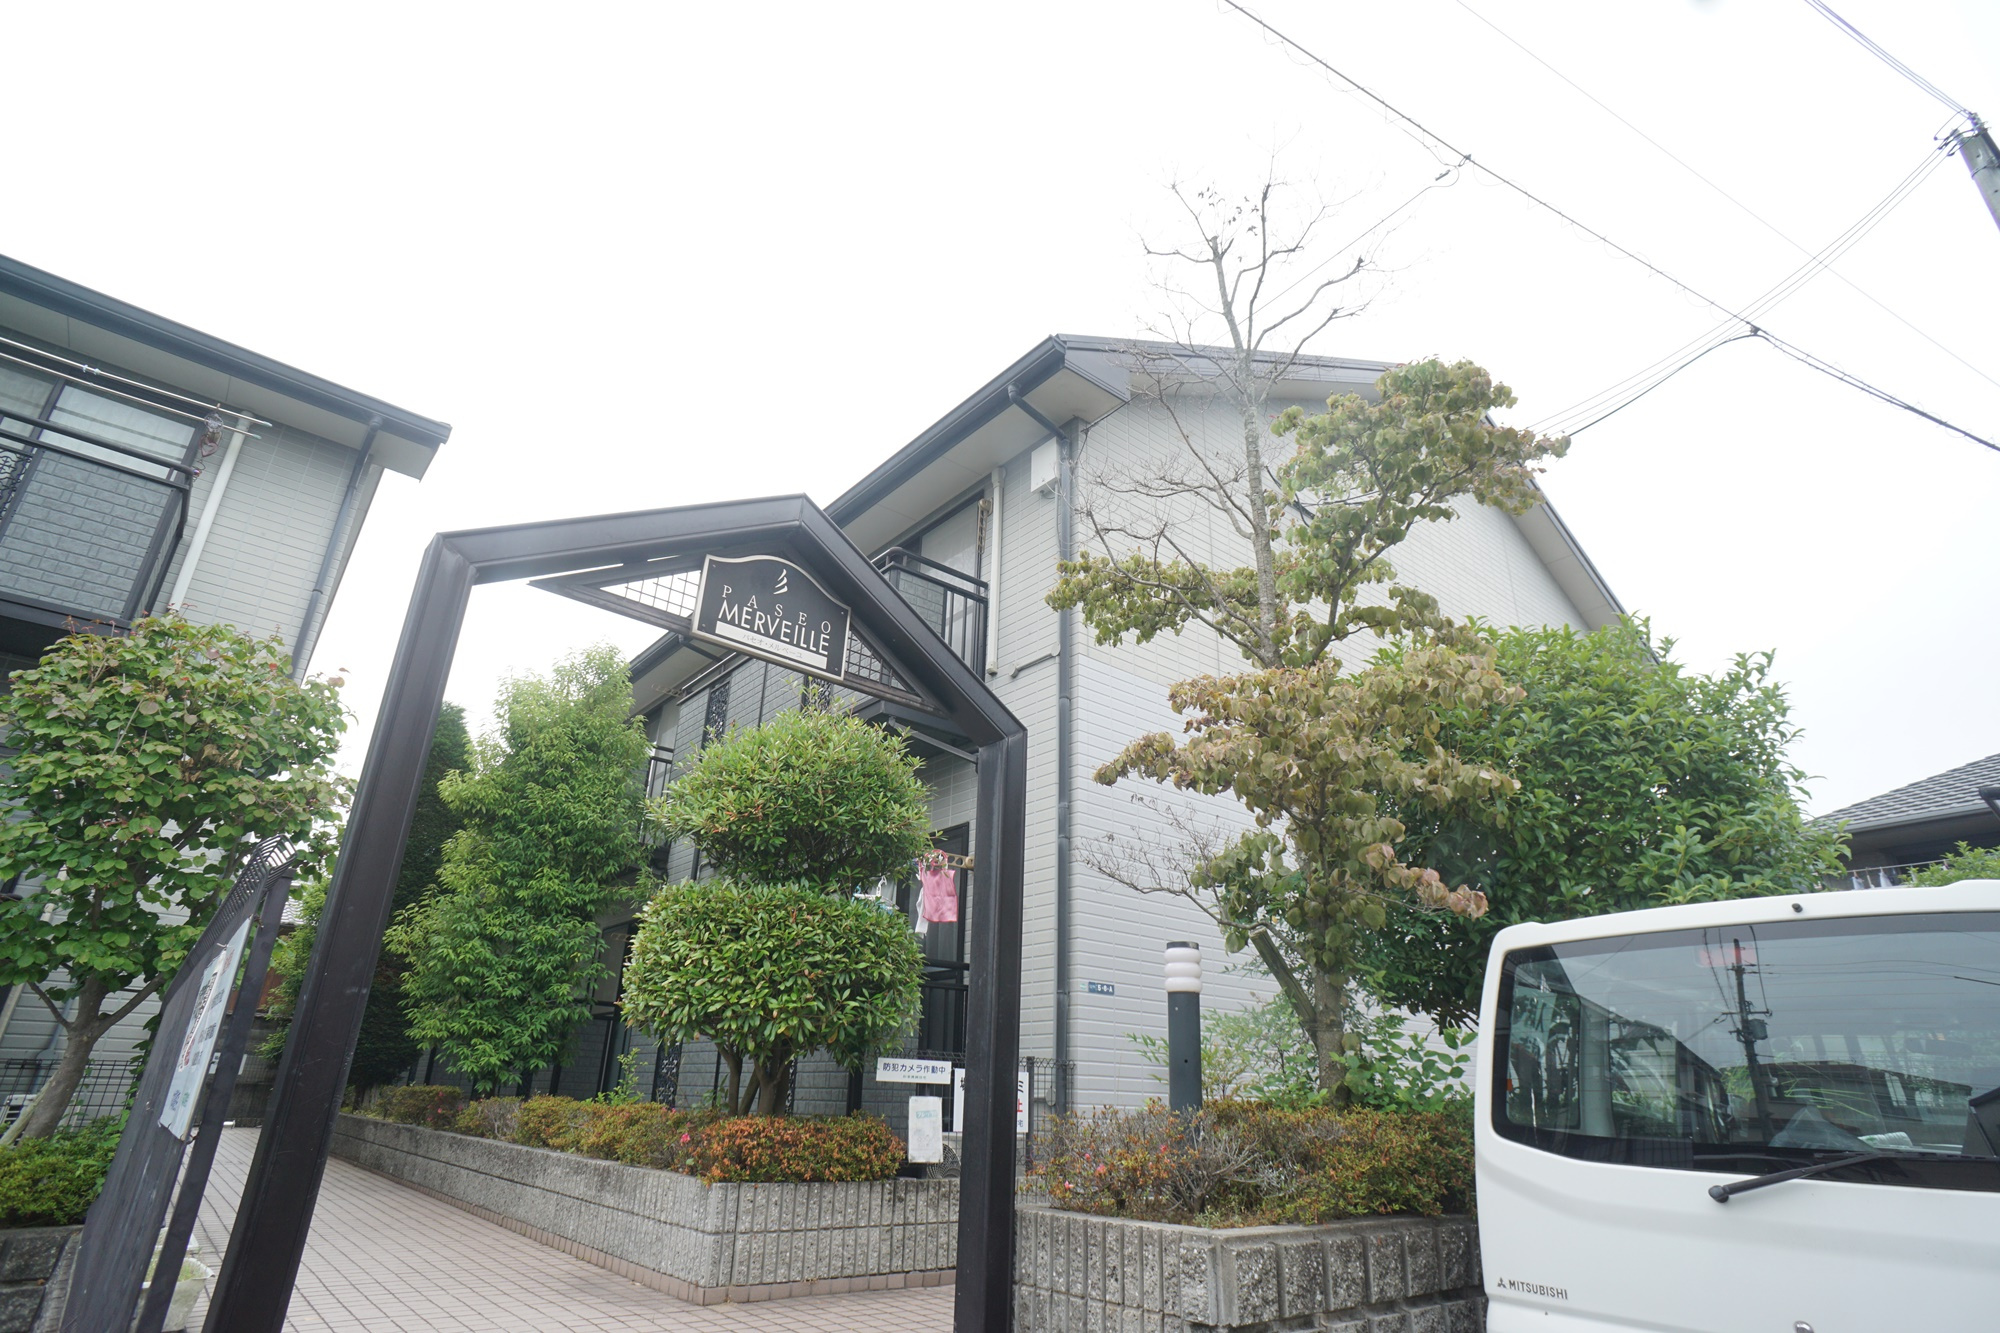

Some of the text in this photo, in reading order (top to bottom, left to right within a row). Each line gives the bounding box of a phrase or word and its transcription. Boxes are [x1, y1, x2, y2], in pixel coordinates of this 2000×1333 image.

[722, 585, 831, 633] PASEO
[718, 600, 829, 655] MERVEILLE
[882, 1062, 946, 1074] 防犯カメラ作動中
[1508, 1279, 1568, 1300] MITSUBISHI
